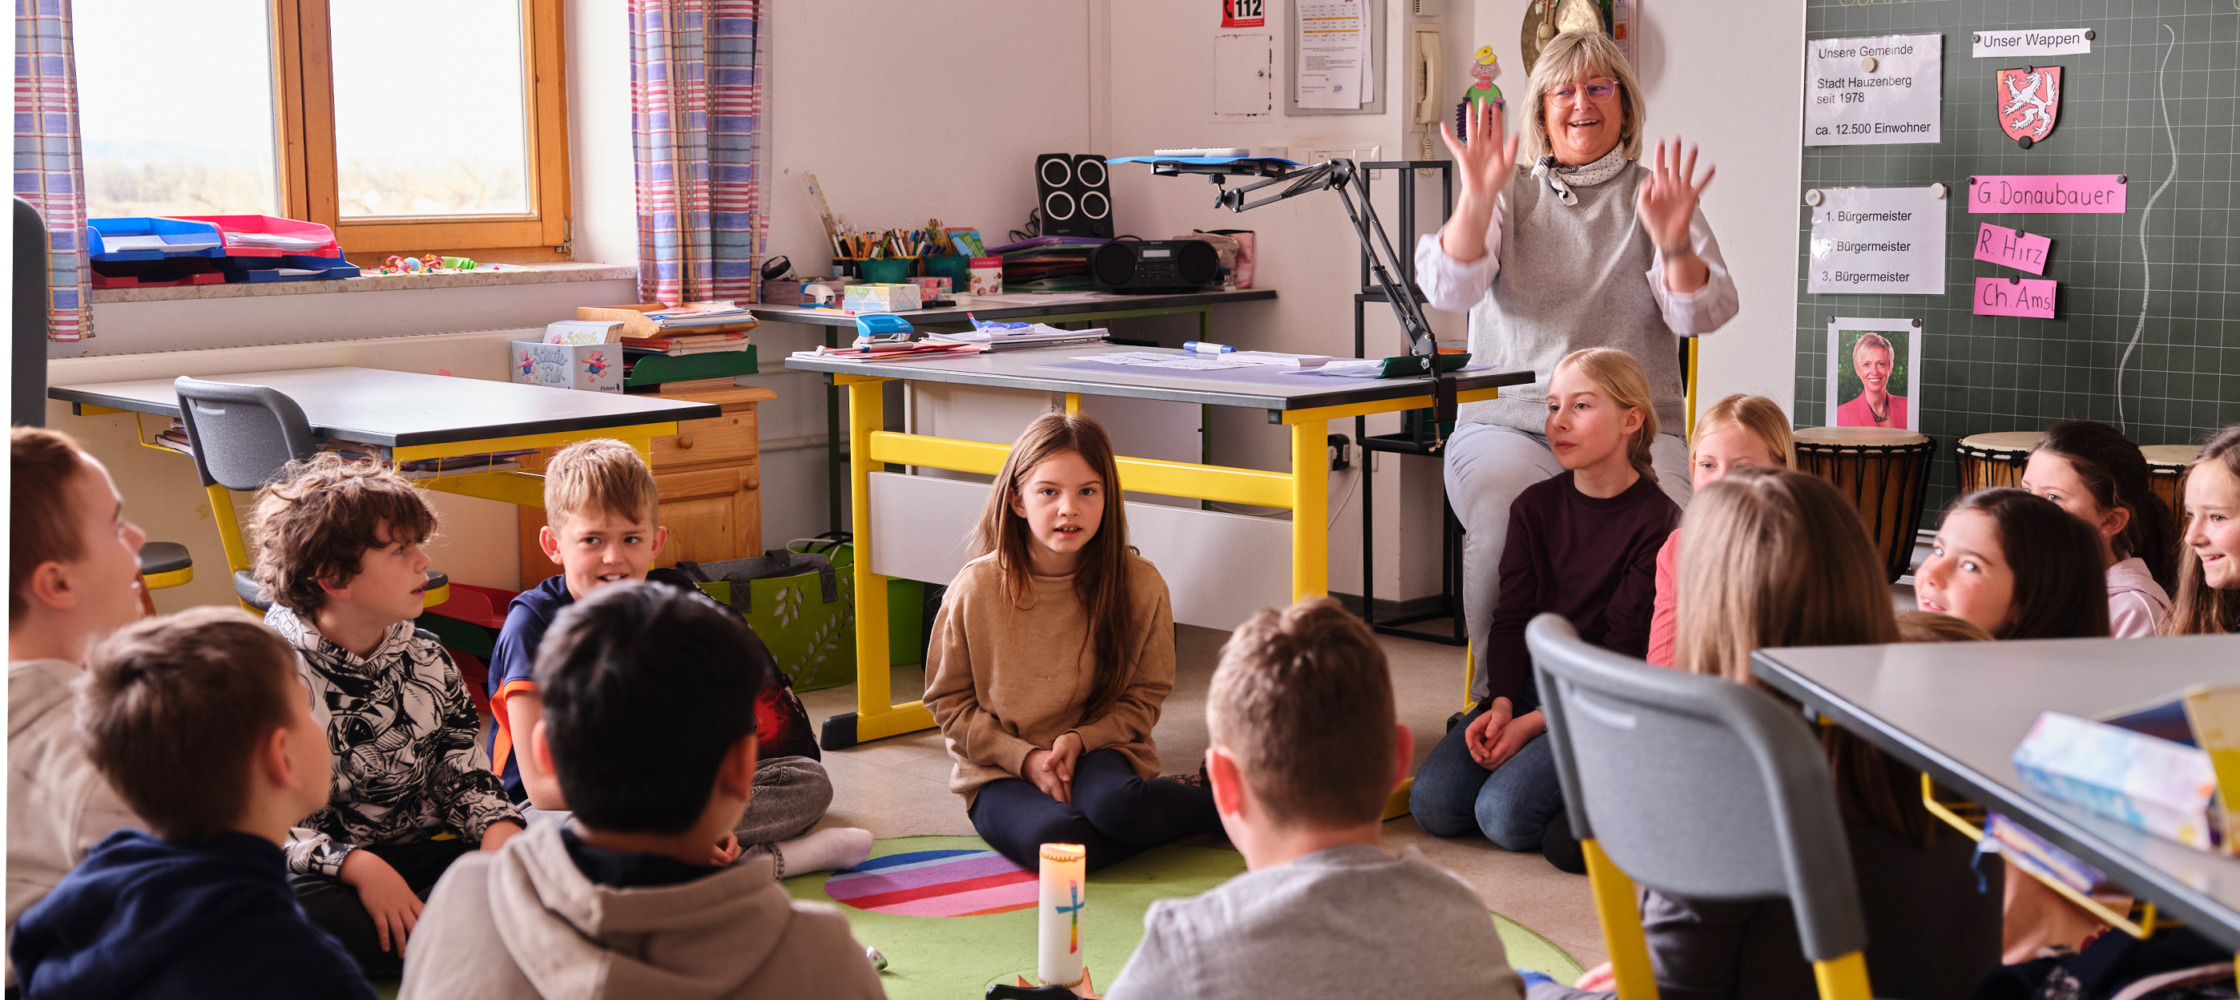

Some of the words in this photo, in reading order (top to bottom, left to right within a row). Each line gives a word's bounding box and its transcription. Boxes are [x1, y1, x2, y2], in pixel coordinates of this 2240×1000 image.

[1236, 0, 1262, 17] 112
[1984, 35, 2021, 48] Unser
[2025, 33, 2080, 48] Wappen
[1818, 48, 1856, 59] Unsere
[1859, 44, 1914, 57] Gemeinde
[1817, 78, 1845, 89] Stadt
[1848, 76, 1912, 88] Hauzenberg
[1816, 93, 1836, 104] seit
[1839, 92, 1865, 103] 1978
[1815, 126, 1831, 135] ca.
[1835, 123, 1872, 135] 12.500
[1874, 122, 1931, 134] Einwohner
[1977, 181, 1997, 204] G.
[1999, 180, 2115, 206] Donaubauer
[1825, 211, 1835, 222] 1.
[1838, 210, 1912, 224] Bürgermeister
[1836, 241, 1911, 254] Bürgermeister
[1979, 228, 1995, 255] R.
[2002, 234, 2043, 266] Hirz
[1821, 271, 1832, 282] 3.
[1835, 271, 1910, 285] Bürgermeister
[1983, 283, 2013, 308] Ch.
